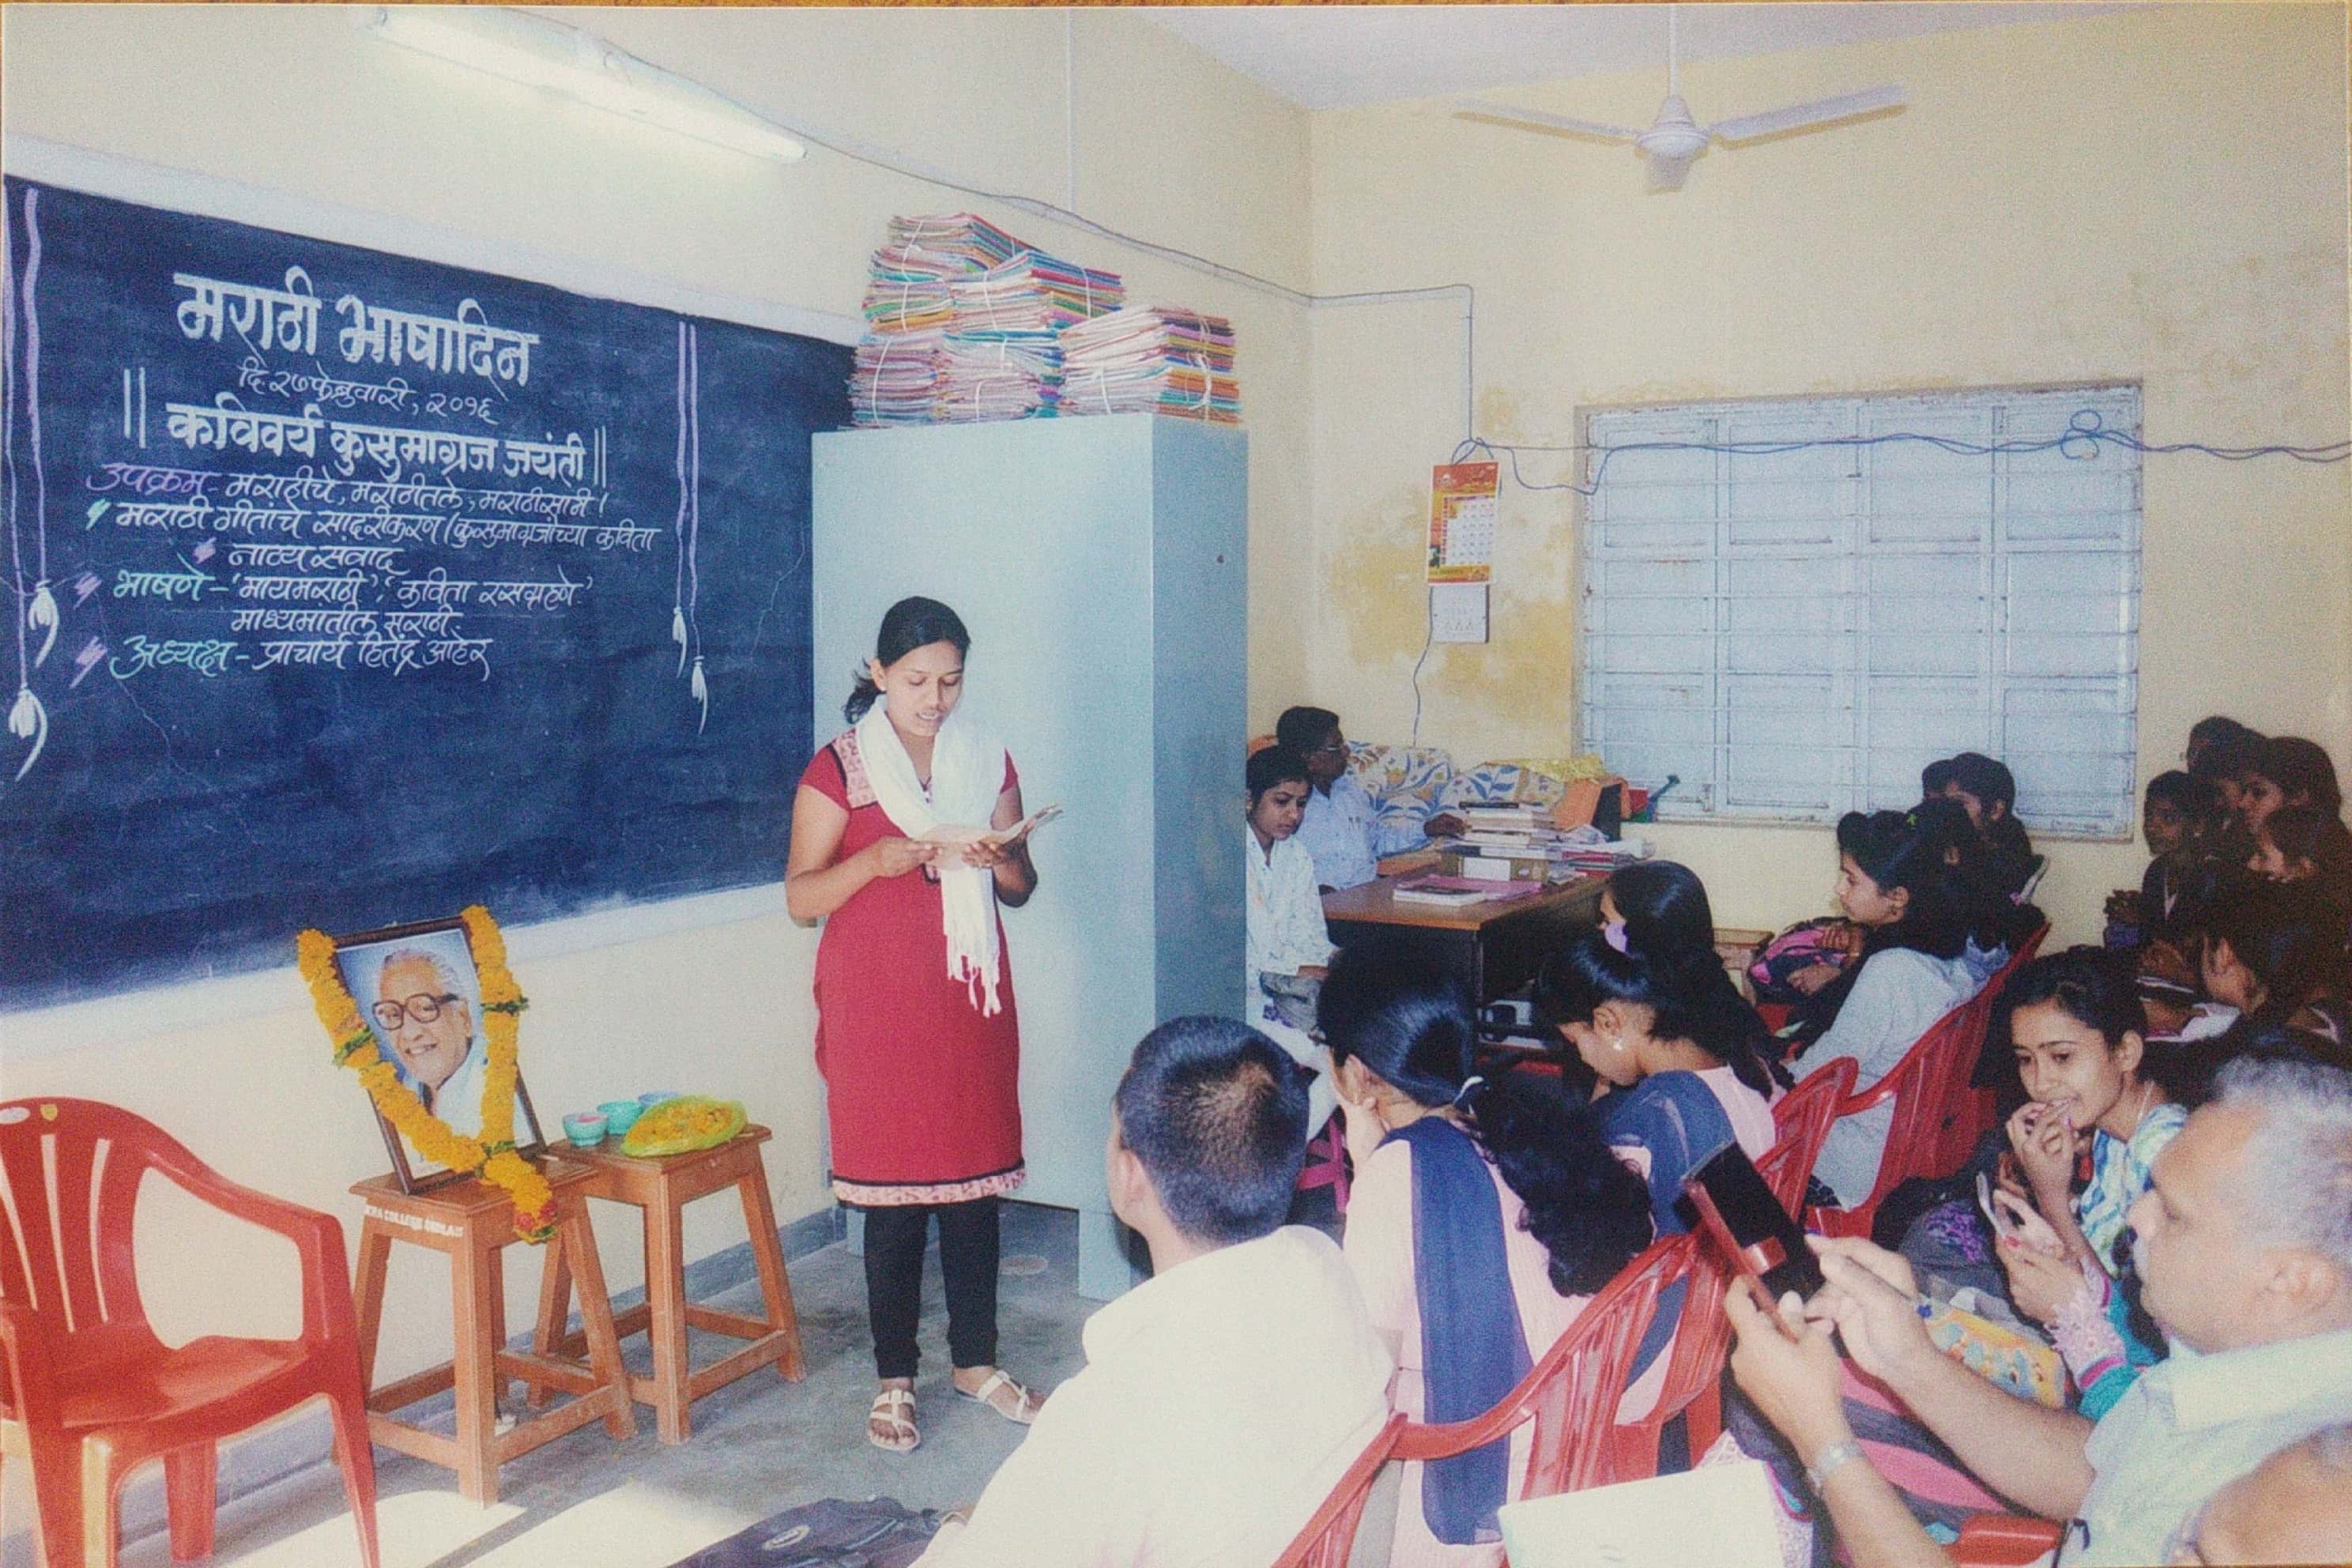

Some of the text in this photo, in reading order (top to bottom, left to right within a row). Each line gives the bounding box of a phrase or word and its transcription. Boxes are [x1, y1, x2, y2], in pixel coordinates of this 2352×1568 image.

[173, 266, 322, 367] मराठी
[427, 394, 499, 424] २०१६
[166, 392, 324, 458] कविवर्य
[330, 421, 499, 482] कुसुमाग्रज
[503, 432, 586, 488] जयंती
[116, 495, 213, 530] मराठी
[313, 507, 446, 545] सादरीकरण
[597, 518, 662, 552] कविता
[252, 632, 353, 670] प्राचार्य
[422, 628, 494, 682] आहेर
